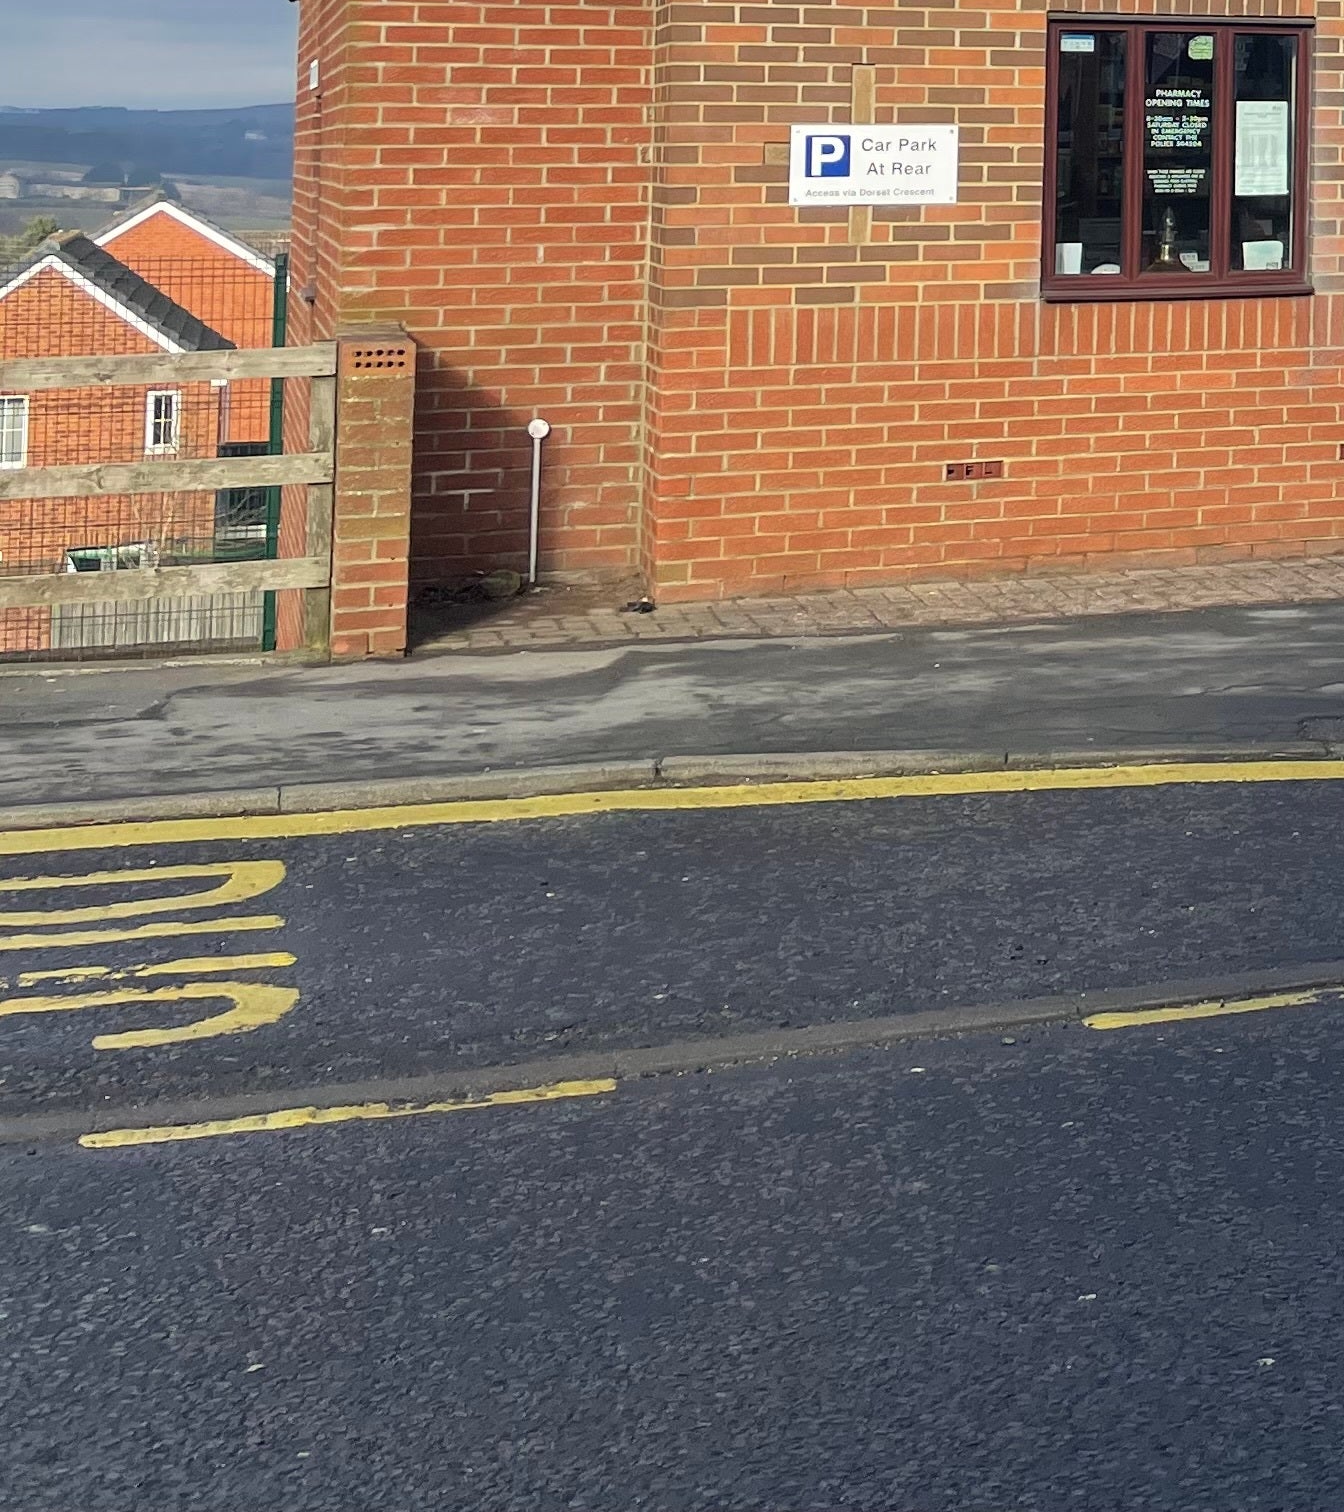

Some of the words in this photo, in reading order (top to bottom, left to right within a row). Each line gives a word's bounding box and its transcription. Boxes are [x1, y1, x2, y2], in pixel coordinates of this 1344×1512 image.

[1156, 89, 1202, 98] PHARMACY
[1145, 99, 1183, 107] OPENING
[1186, 99, 1210, 108] TIMES
[861, 138, 892, 152] Car
[898, 138, 937, 152] Park
[811, 137, 845, 176] P
[866, 162, 885, 175] At
[891, 162, 931, 175] Rear
[805, 189, 840, 197] Access
[842, 189, 857, 197] via
[893, 188, 935, 196] Crescent
